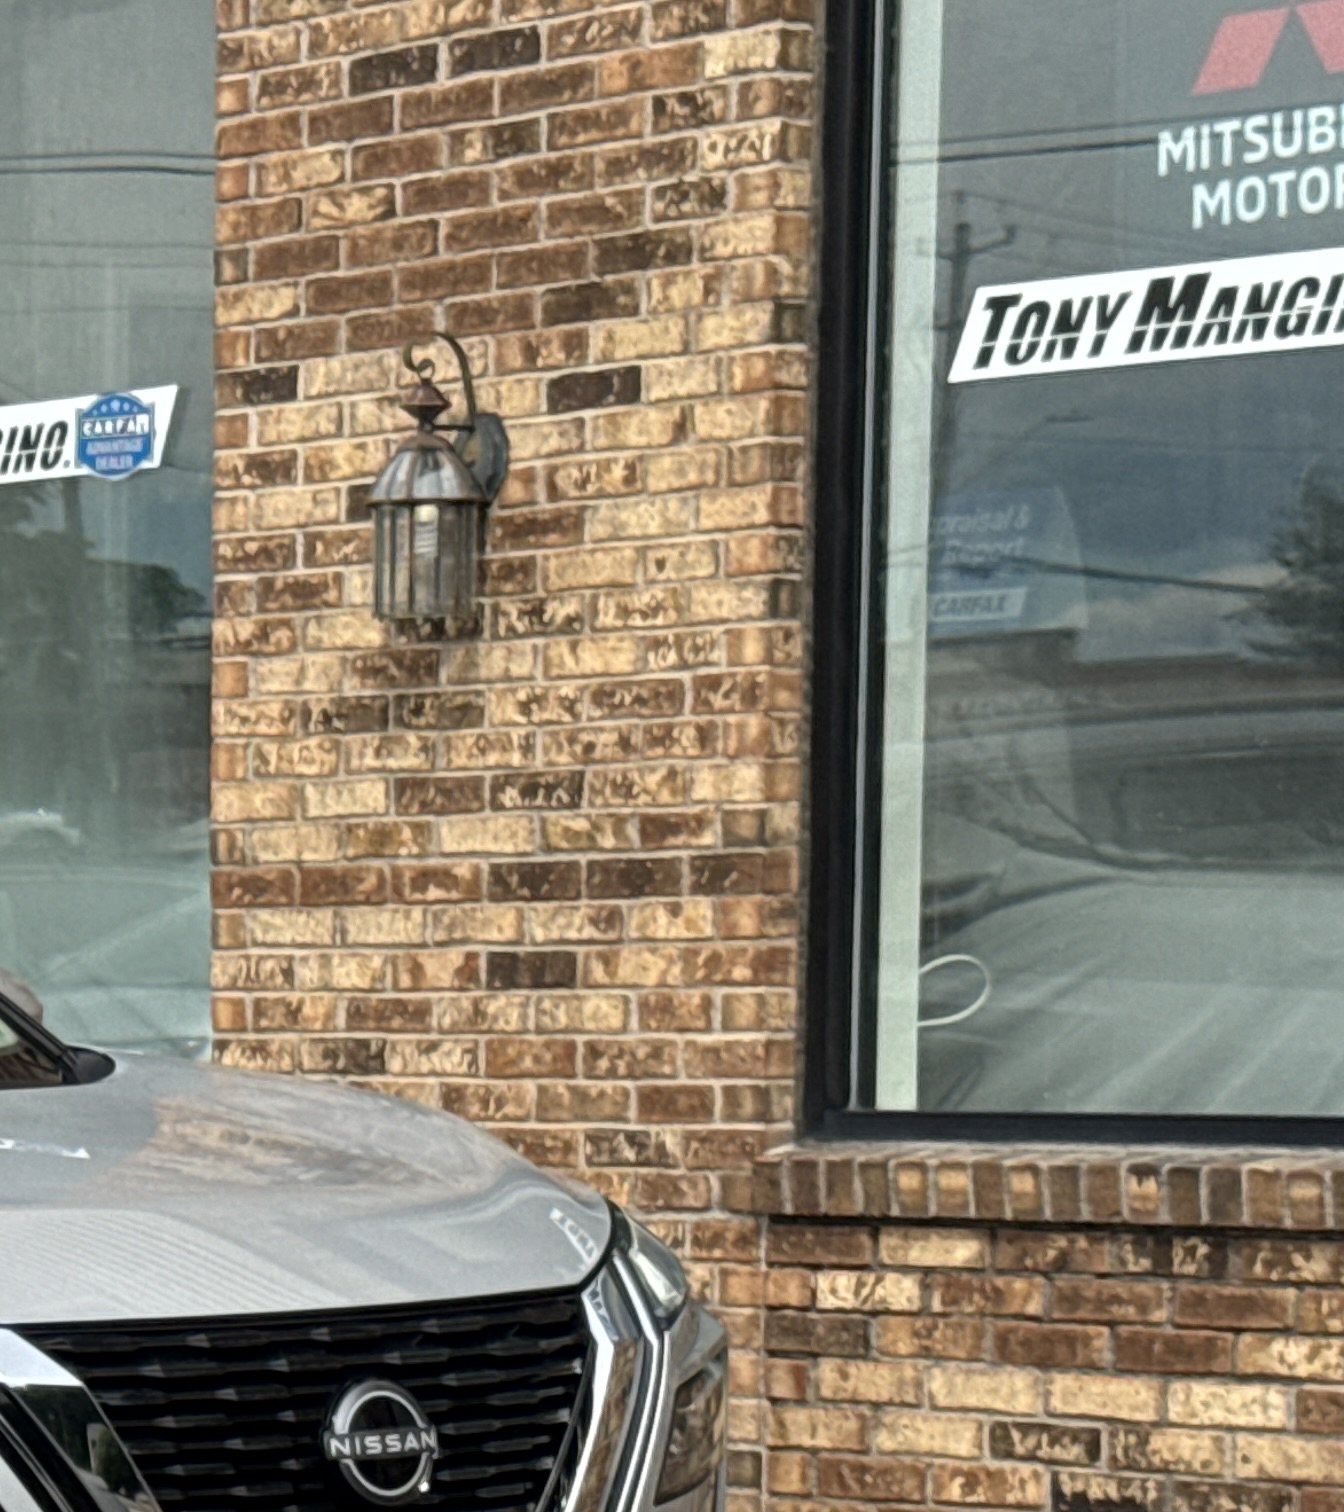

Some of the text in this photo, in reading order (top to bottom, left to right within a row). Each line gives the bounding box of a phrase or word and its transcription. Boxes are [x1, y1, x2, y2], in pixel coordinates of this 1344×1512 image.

[1157, 104, 1344, 177] MITSUB
[972, 271, 1344, 370] TONY MANGI
[330, 1430, 437, 1457] NISSAN
